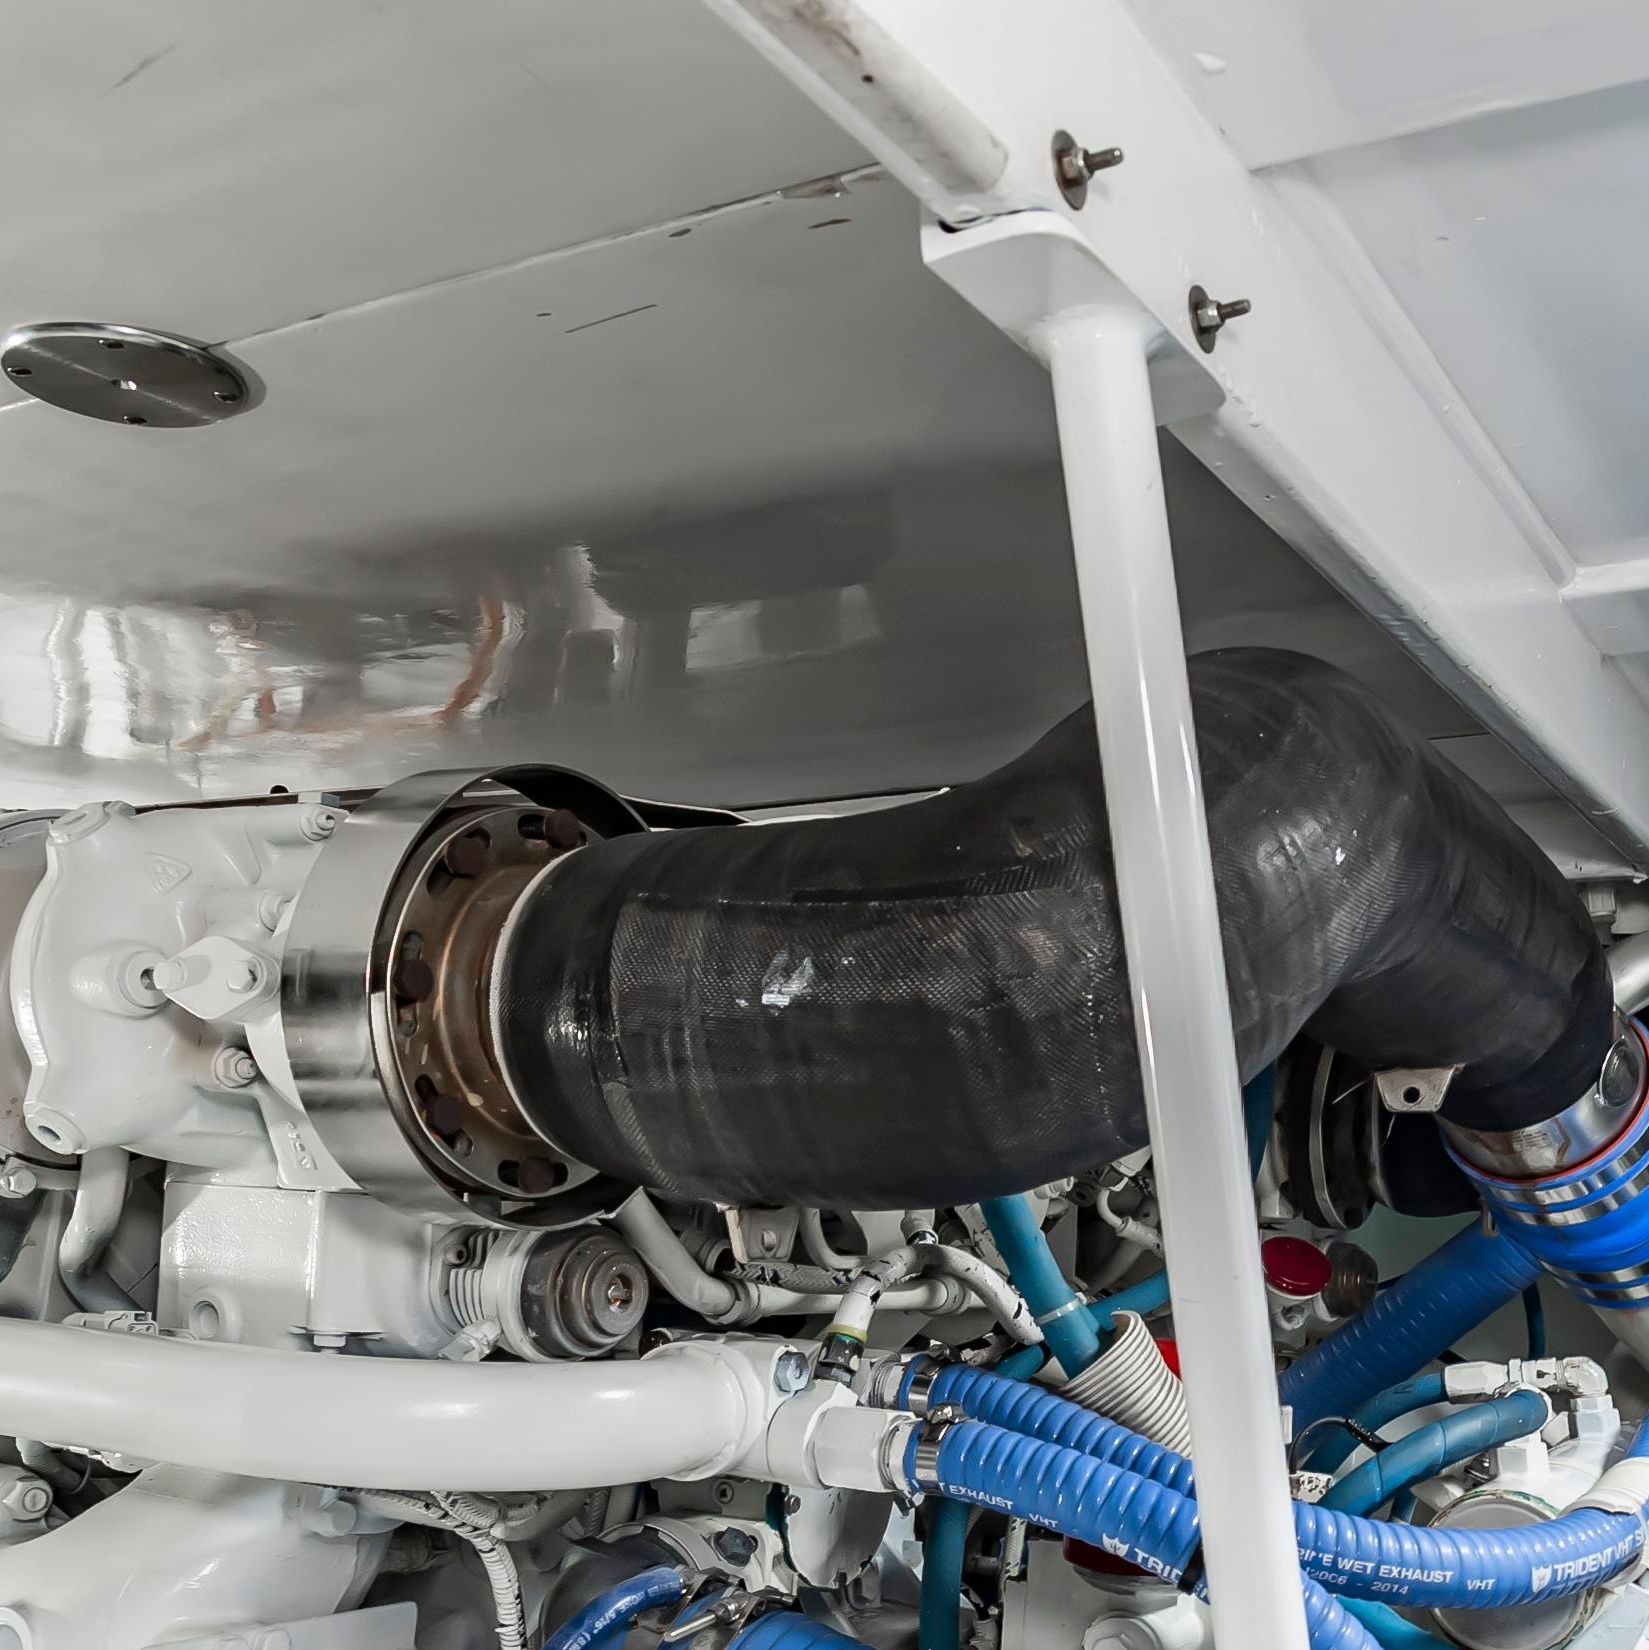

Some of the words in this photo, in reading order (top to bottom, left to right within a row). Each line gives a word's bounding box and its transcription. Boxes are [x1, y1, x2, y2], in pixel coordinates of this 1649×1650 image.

[949, 1484, 1015, 1510] EXHAUST
[1028, 1512, 1060, 1529] VHT
[1337, 1557, 1375, 1575] WET
[1378, 1564, 1454, 1584] EXHAUST
[1467, 1578, 1496, 1591] VHT
[1553, 1547, 1614, 1582] TRIDENT
[1370, 1581, 1409, 1595] 2014
